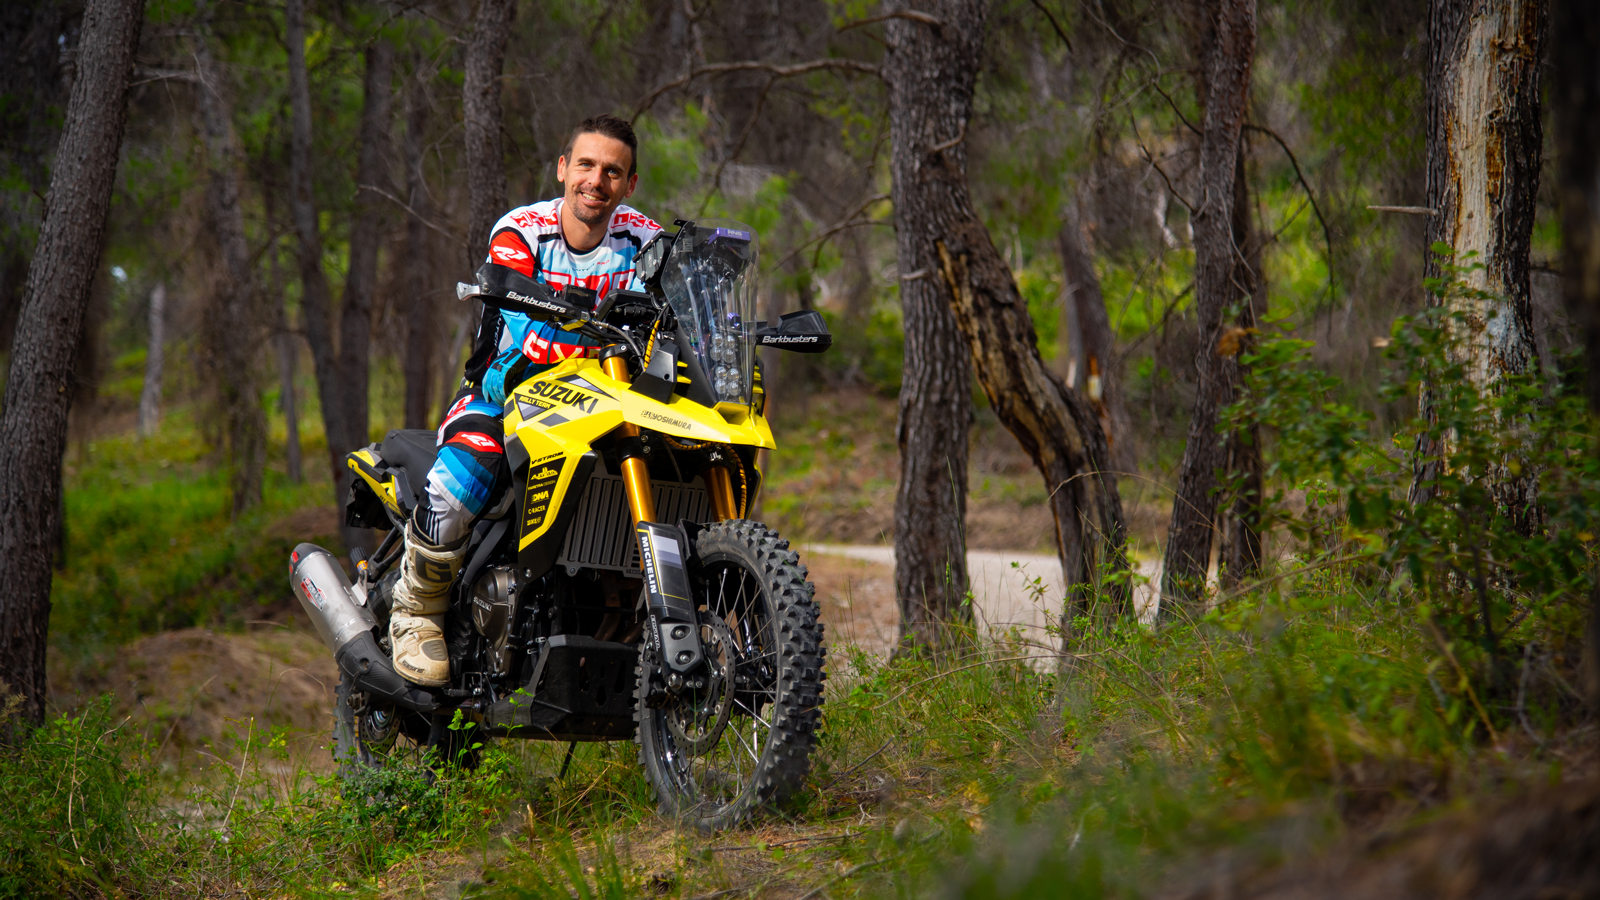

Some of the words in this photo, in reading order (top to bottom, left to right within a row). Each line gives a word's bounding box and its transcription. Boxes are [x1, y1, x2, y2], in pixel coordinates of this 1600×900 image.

[506, 290, 567, 314] Barkbusters
[762, 335, 818, 344] Barkbusters
[528, 381, 599, 414] SUZUKI
[652, 413, 692, 430] YOSHIMURA
[531, 490, 549, 502] DNA
[641, 536, 657, 594] MICHELIN
[473, 596, 492, 611] SUZUKI
